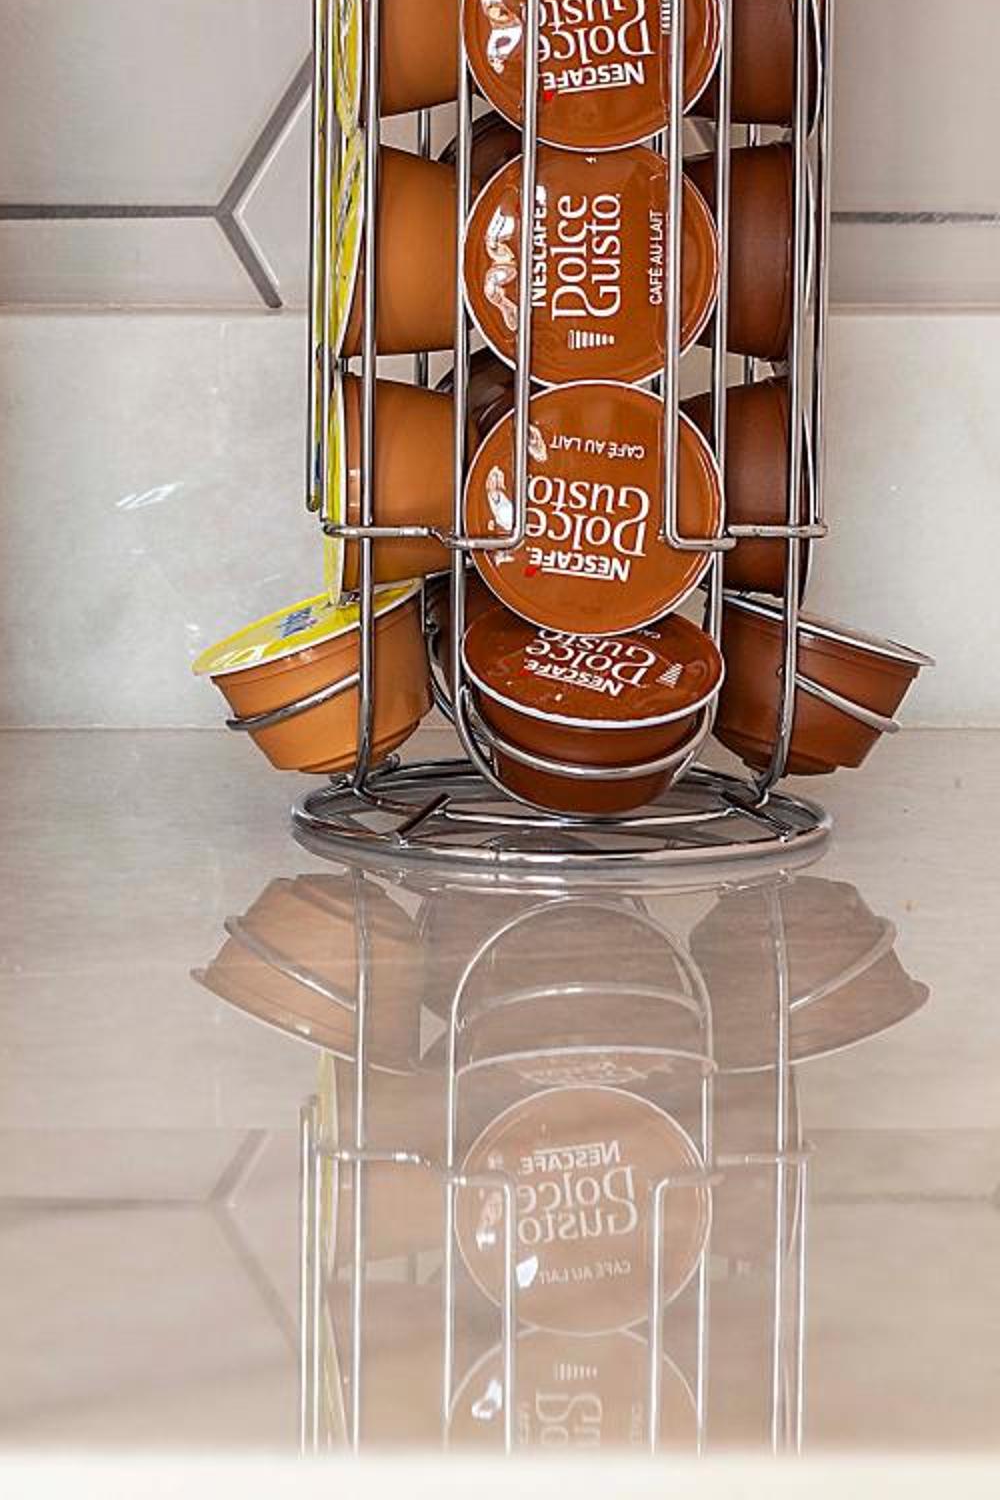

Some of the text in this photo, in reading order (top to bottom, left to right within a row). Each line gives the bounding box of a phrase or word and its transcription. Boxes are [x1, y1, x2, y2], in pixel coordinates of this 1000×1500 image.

[551, 195, 590, 321] Dolce
[588, 193, 621, 318] Gusto
[648, 209, 664, 305] CAFÉ AU LAIT
[550, 435, 644, 460] CAFÉ AU LAIT
[527, 476, 650, 522] Gusto
[525, 507, 646, 556] Dolce
[526, 640, 650, 688] Dolce
